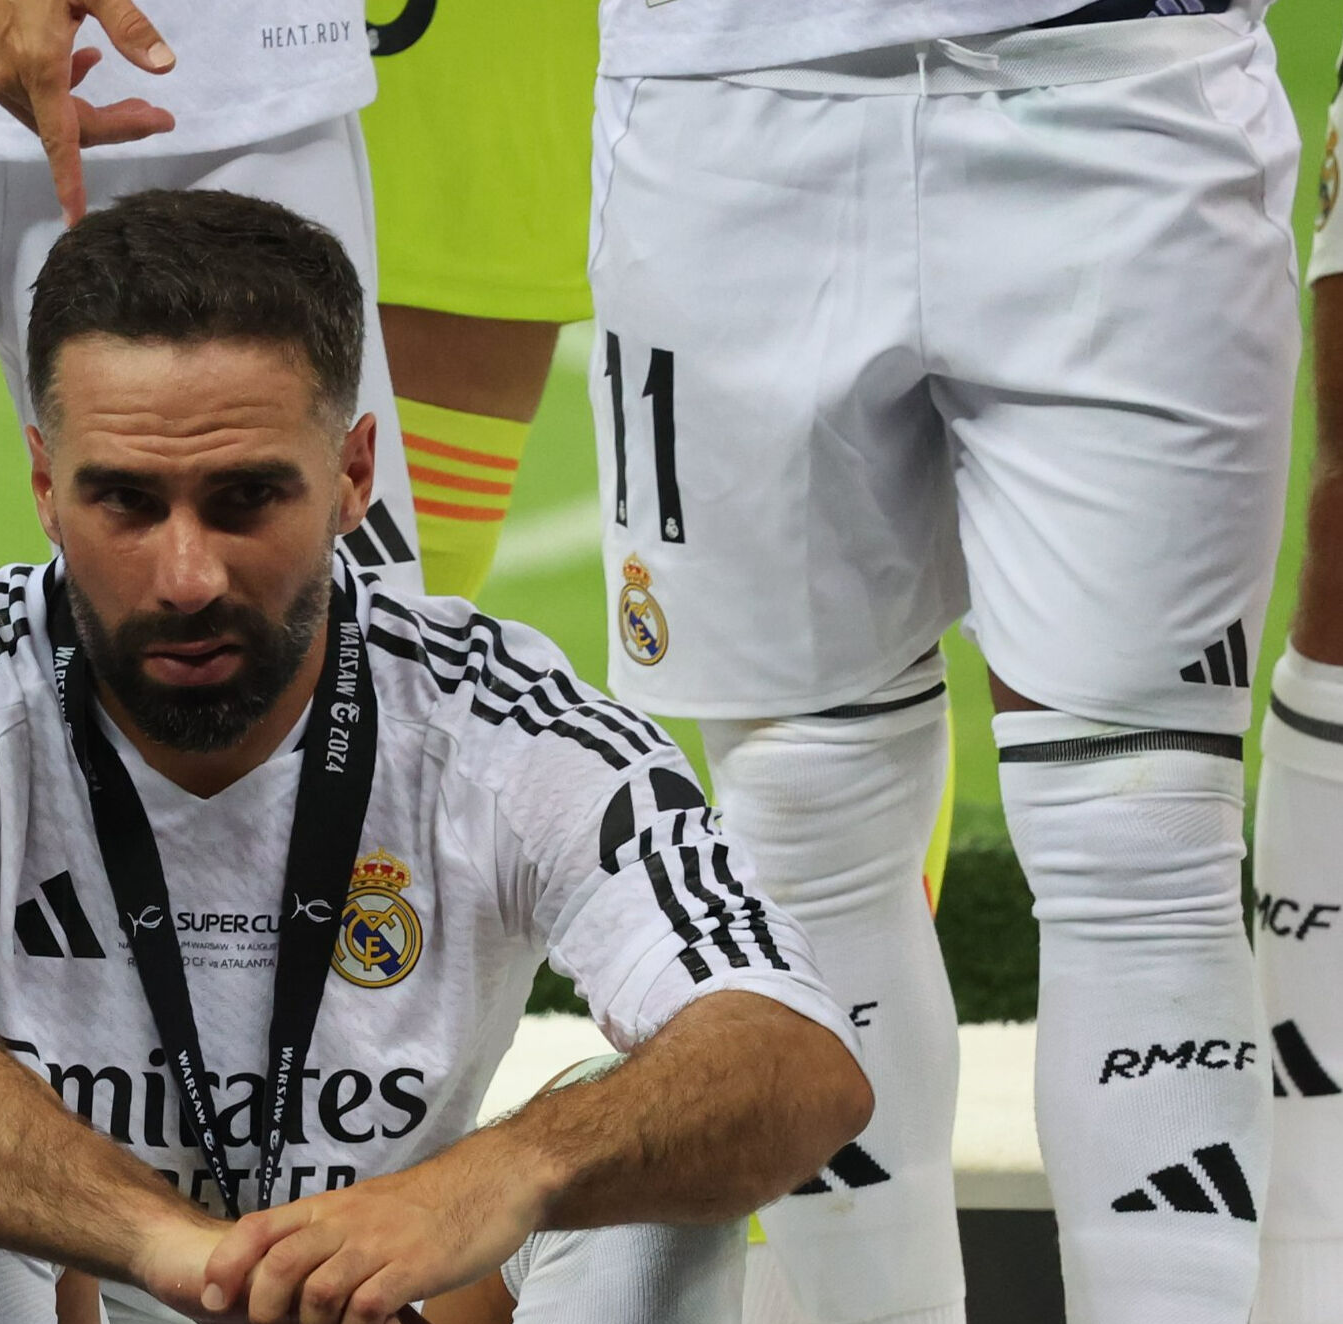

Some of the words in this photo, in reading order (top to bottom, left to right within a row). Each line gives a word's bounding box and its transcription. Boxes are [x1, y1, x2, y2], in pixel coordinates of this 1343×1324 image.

[262, 21, 351, 49] HEAT.RDY
[604, 330, 686, 544] 11
[335, 622, 360, 697] WARSAW
[325, 727, 350, 773] 2024
[177, 912, 250, 934] SUPER
[251, 914, 282, 934] CU
[192, 957, 206, 967] CF
[220, 958, 276, 969] ATALANTA
[272, 1046, 294, 1123] WARSAW
[1099, 1039, 1257, 1085] RMCF
[177, 1049, 207, 1125] WARSAW
